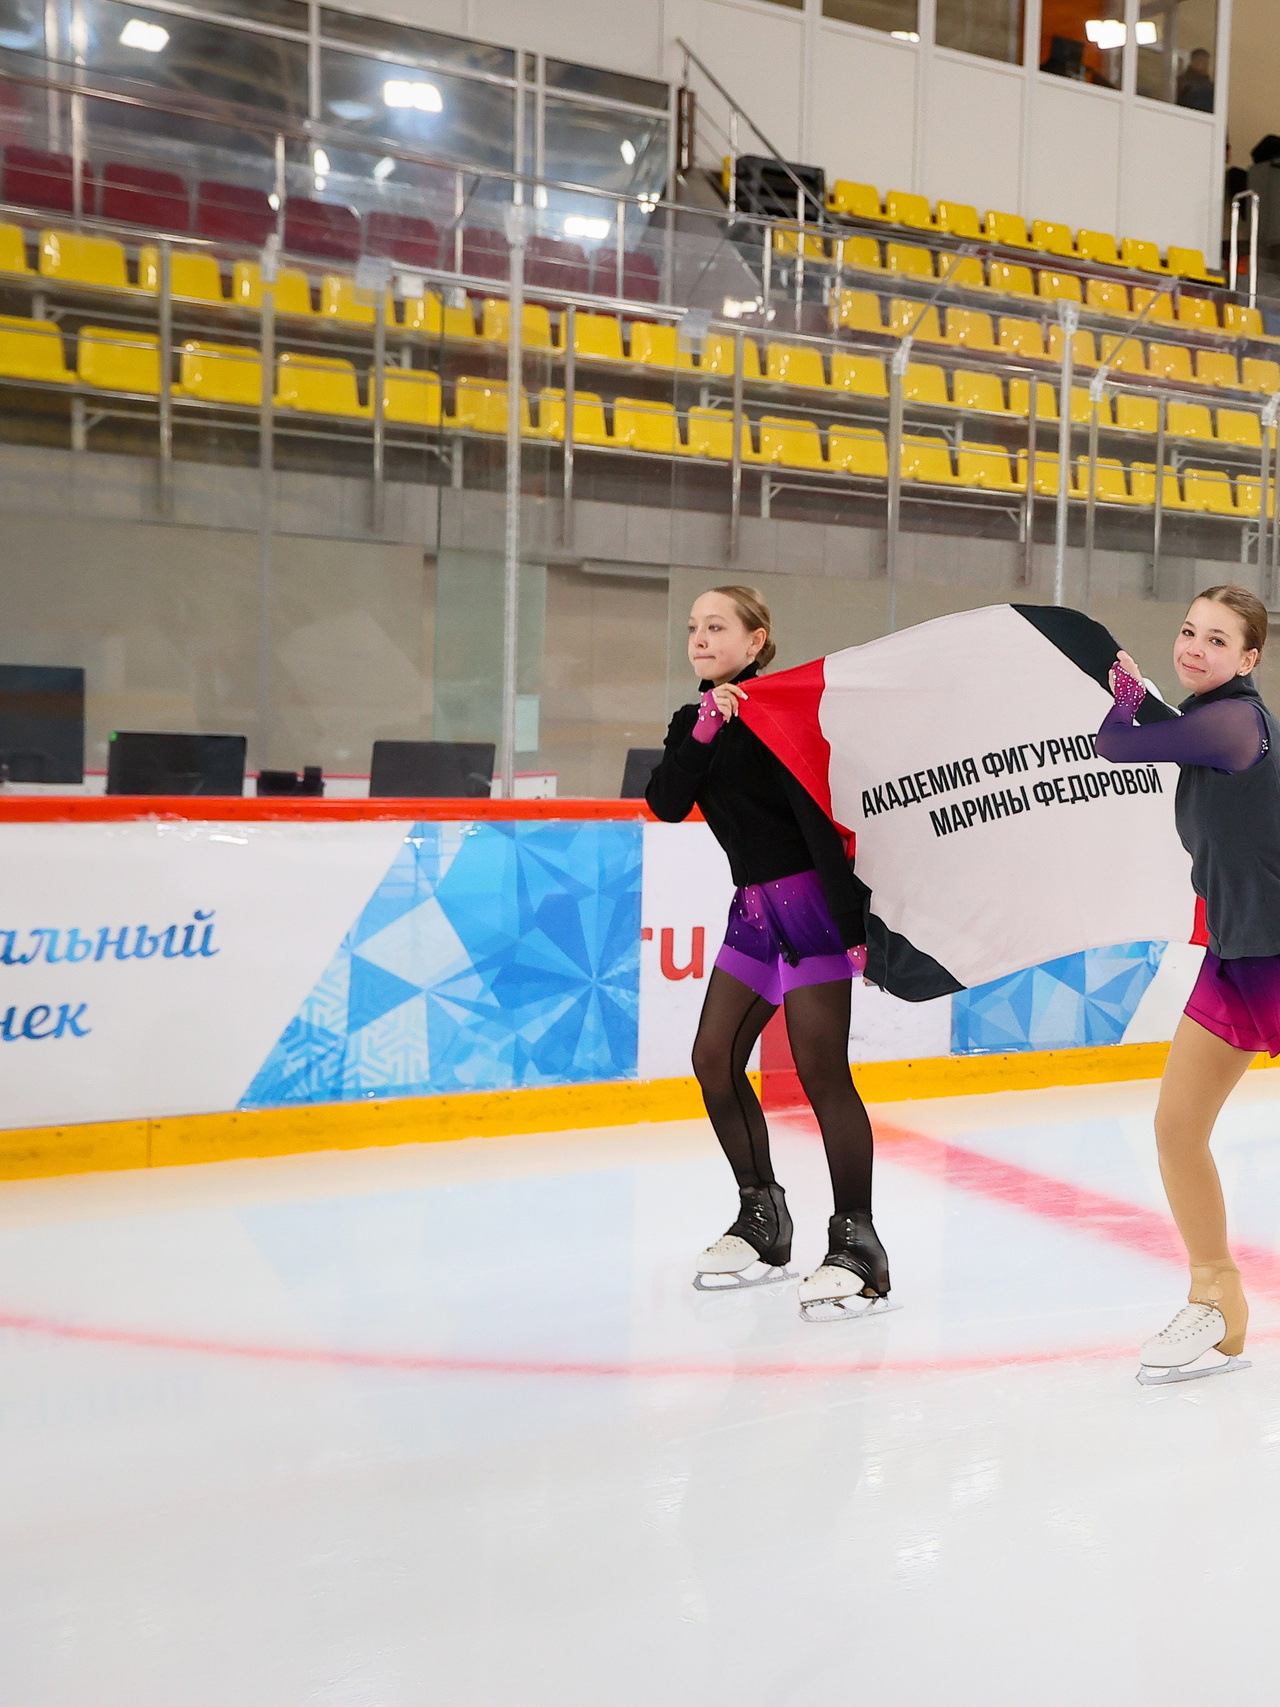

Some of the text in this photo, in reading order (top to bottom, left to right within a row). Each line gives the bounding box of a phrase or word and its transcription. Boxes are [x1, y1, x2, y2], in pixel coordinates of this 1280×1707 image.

[861, 757, 980, 818] АКАДЕМИЯ
[929, 764, 1164, 838] МАРИНЫ ФЕДОРОВОЙ
